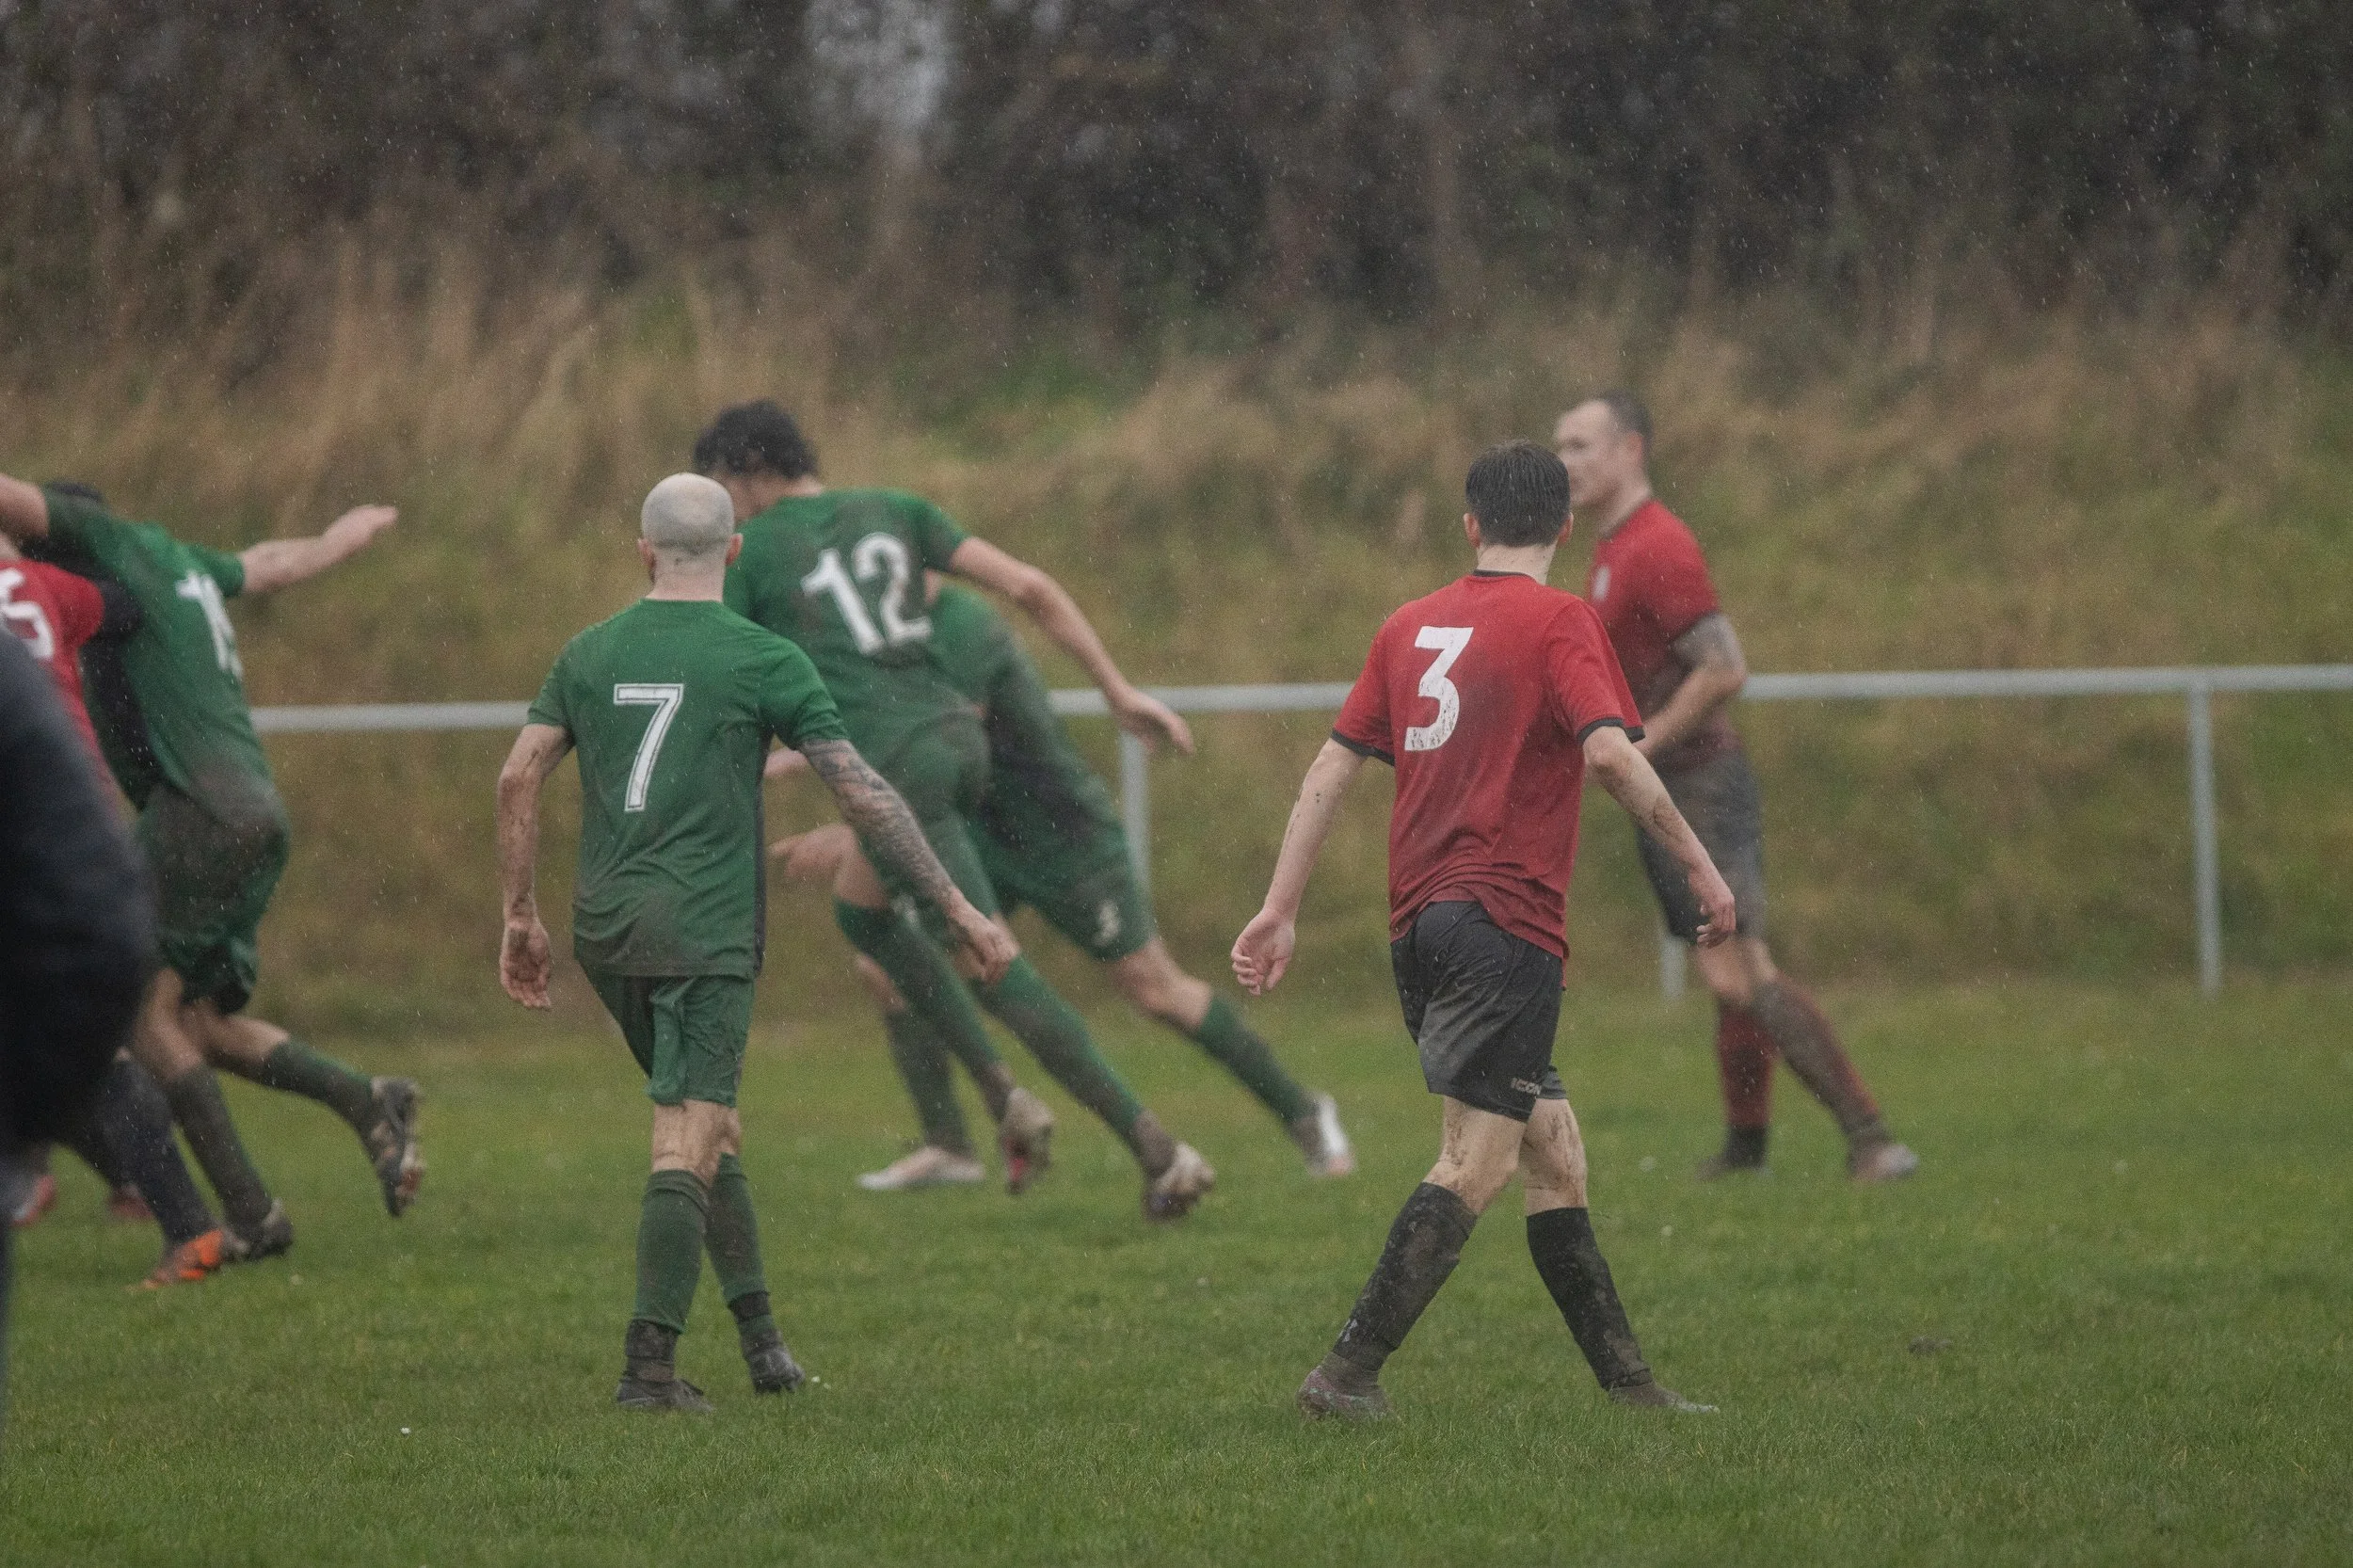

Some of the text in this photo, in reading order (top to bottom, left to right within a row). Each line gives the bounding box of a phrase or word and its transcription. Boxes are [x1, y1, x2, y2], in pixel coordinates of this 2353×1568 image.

[800, 533, 934, 655] 12
[614, 683, 684, 811] 7
[1404, 625, 1474, 751] 3
